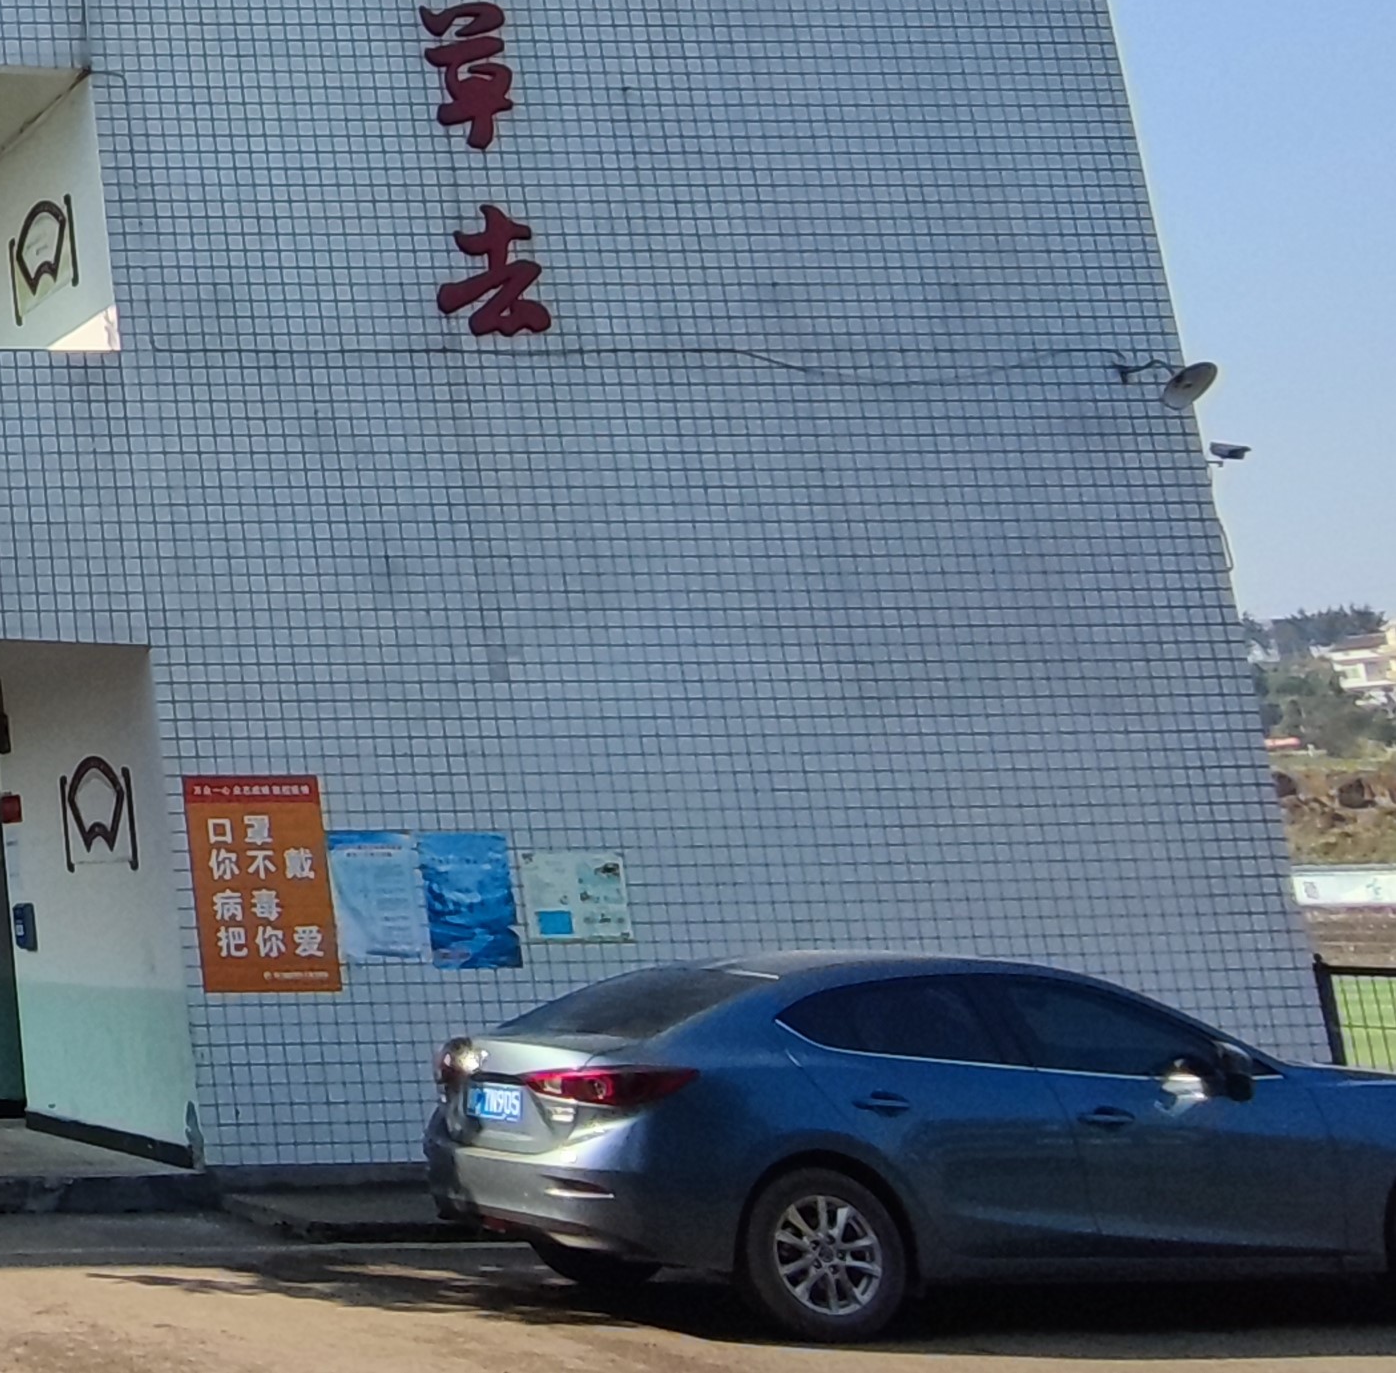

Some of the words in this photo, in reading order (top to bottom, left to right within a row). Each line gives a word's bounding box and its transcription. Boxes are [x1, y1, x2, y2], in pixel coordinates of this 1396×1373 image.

[207, 815, 273, 846] 口罩
[209, 847, 315, 880] 你不戴
[212, 888, 282, 922] 病毒
[216, 925, 325, 958] 把你爱
